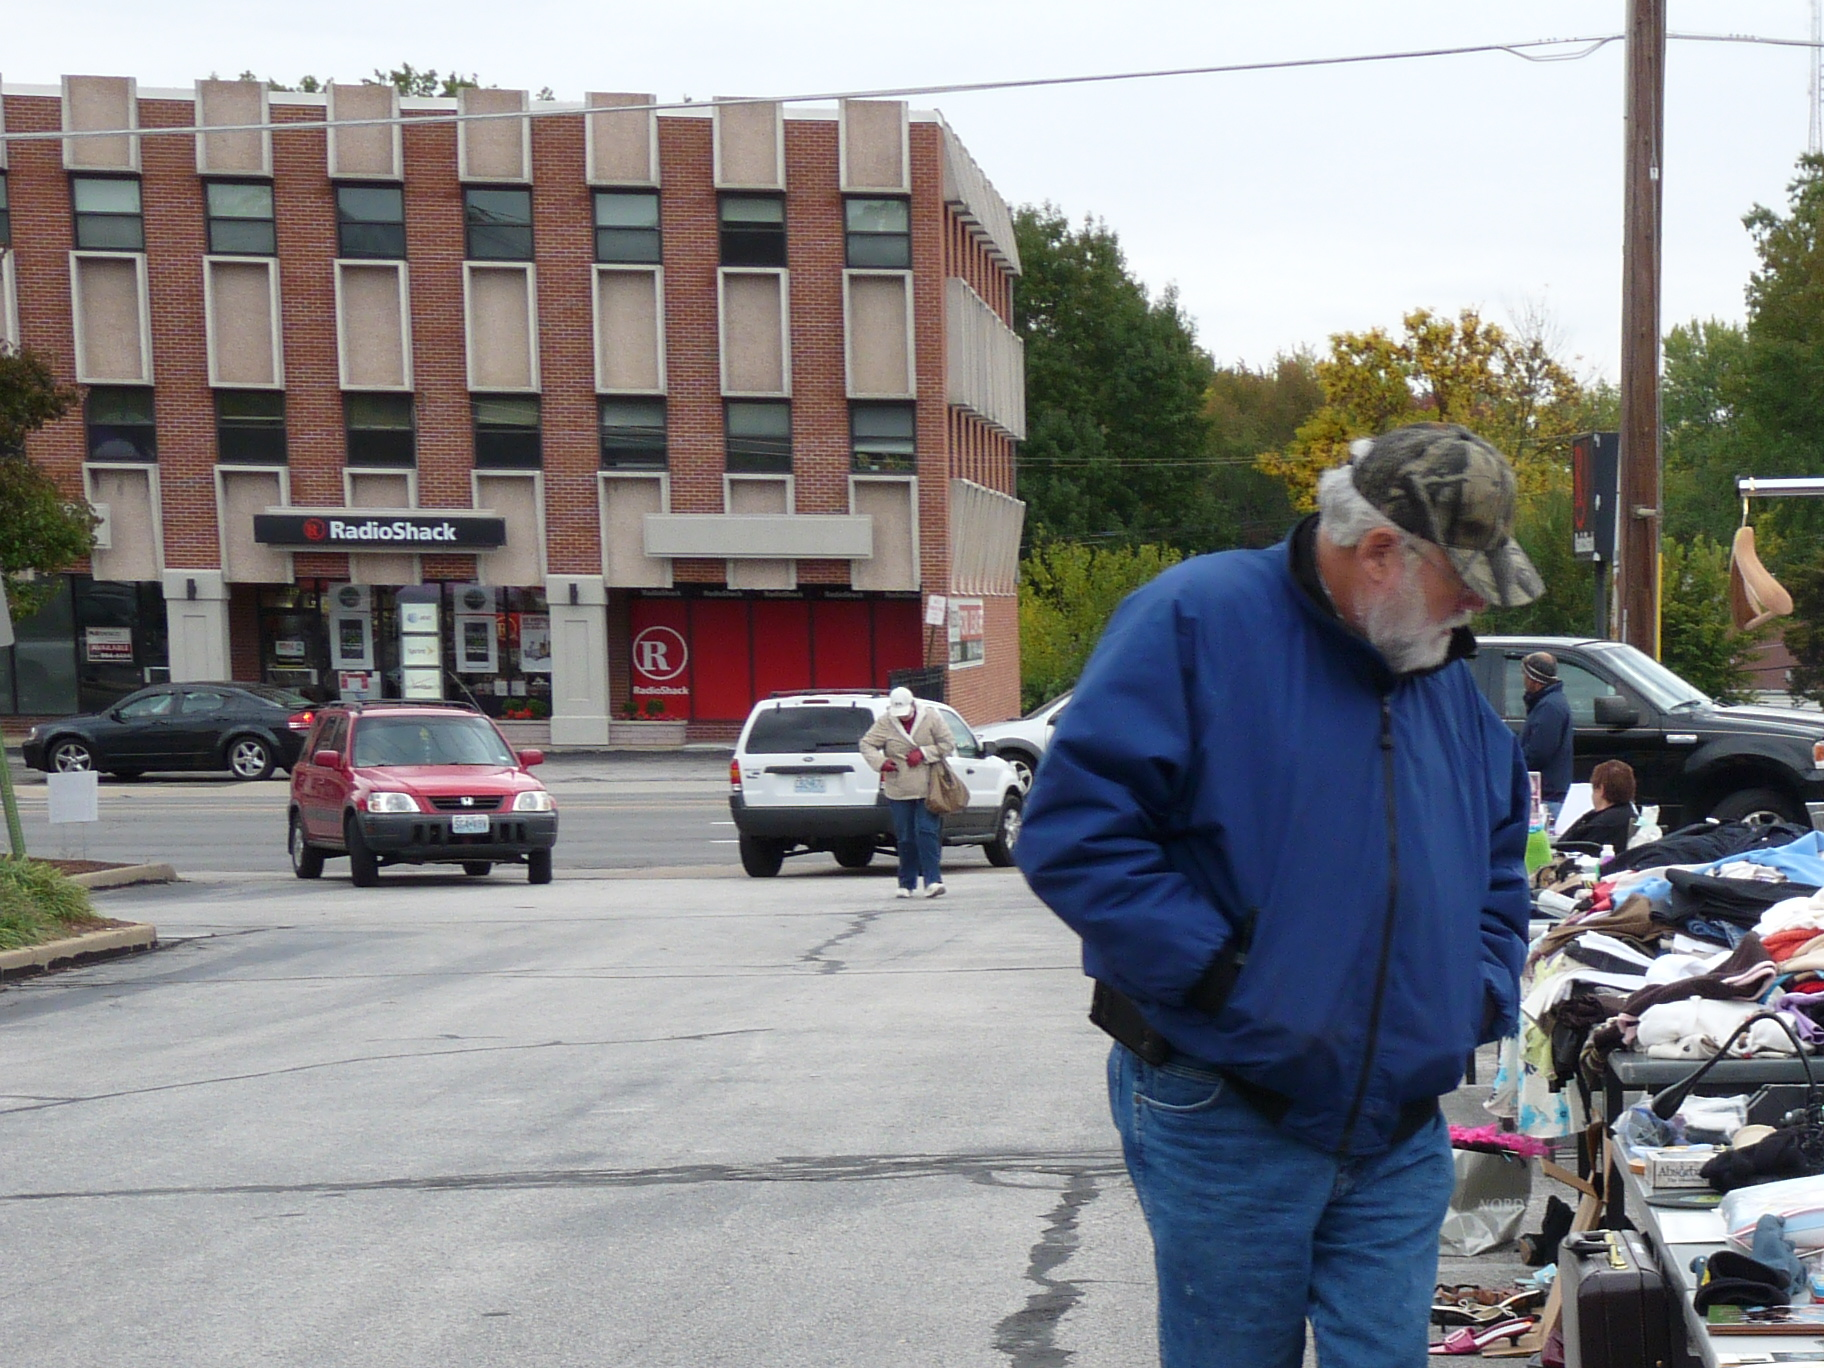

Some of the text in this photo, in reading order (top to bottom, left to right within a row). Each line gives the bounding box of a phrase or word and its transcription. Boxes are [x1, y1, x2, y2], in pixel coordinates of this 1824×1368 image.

[330, 521, 457, 541] RadioShack
[639, 640, 671, 670] R
[633, 686, 690, 695] RadioShack
